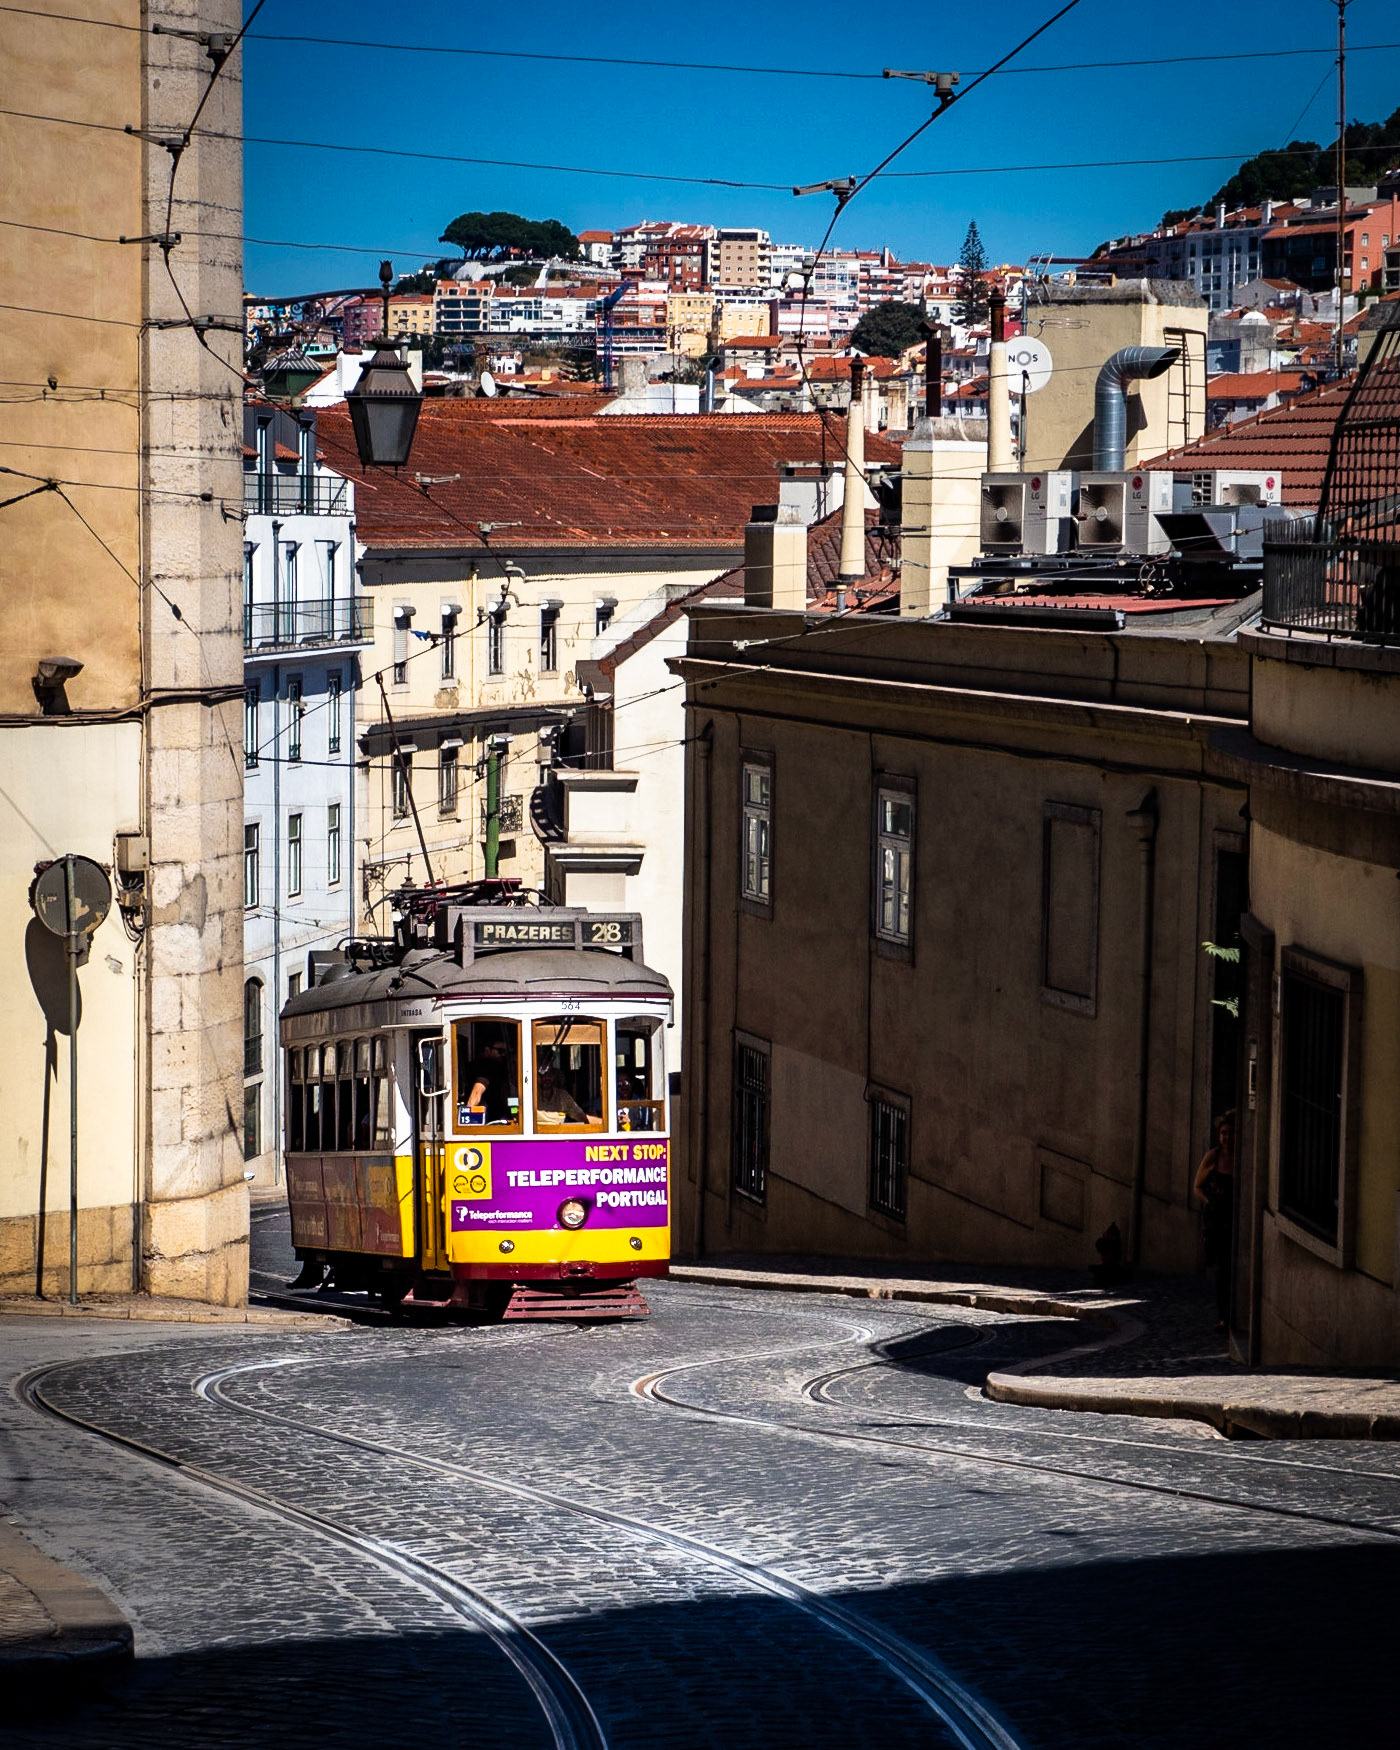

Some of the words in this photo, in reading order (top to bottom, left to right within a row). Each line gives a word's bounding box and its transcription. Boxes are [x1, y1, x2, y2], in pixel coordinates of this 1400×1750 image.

[1008, 351, 1038, 366] NOS
[1031, 491, 1040, 500] LG
[1132, 491, 1142, 500] LG
[1266, 492, 1274, 500] LG
[483, 924, 573, 940] PRAZERES
[591, 922, 621, 943] 28
[585, 1145, 629, 1162] NEXT
[633, 1144, 667, 1161] STOP:
[507, 1167, 667, 1187] TELEPERFORMANCE
[596, 1190, 667, 1208] PORTUGAL
[469, 1210, 533, 1221] Teleperformance
